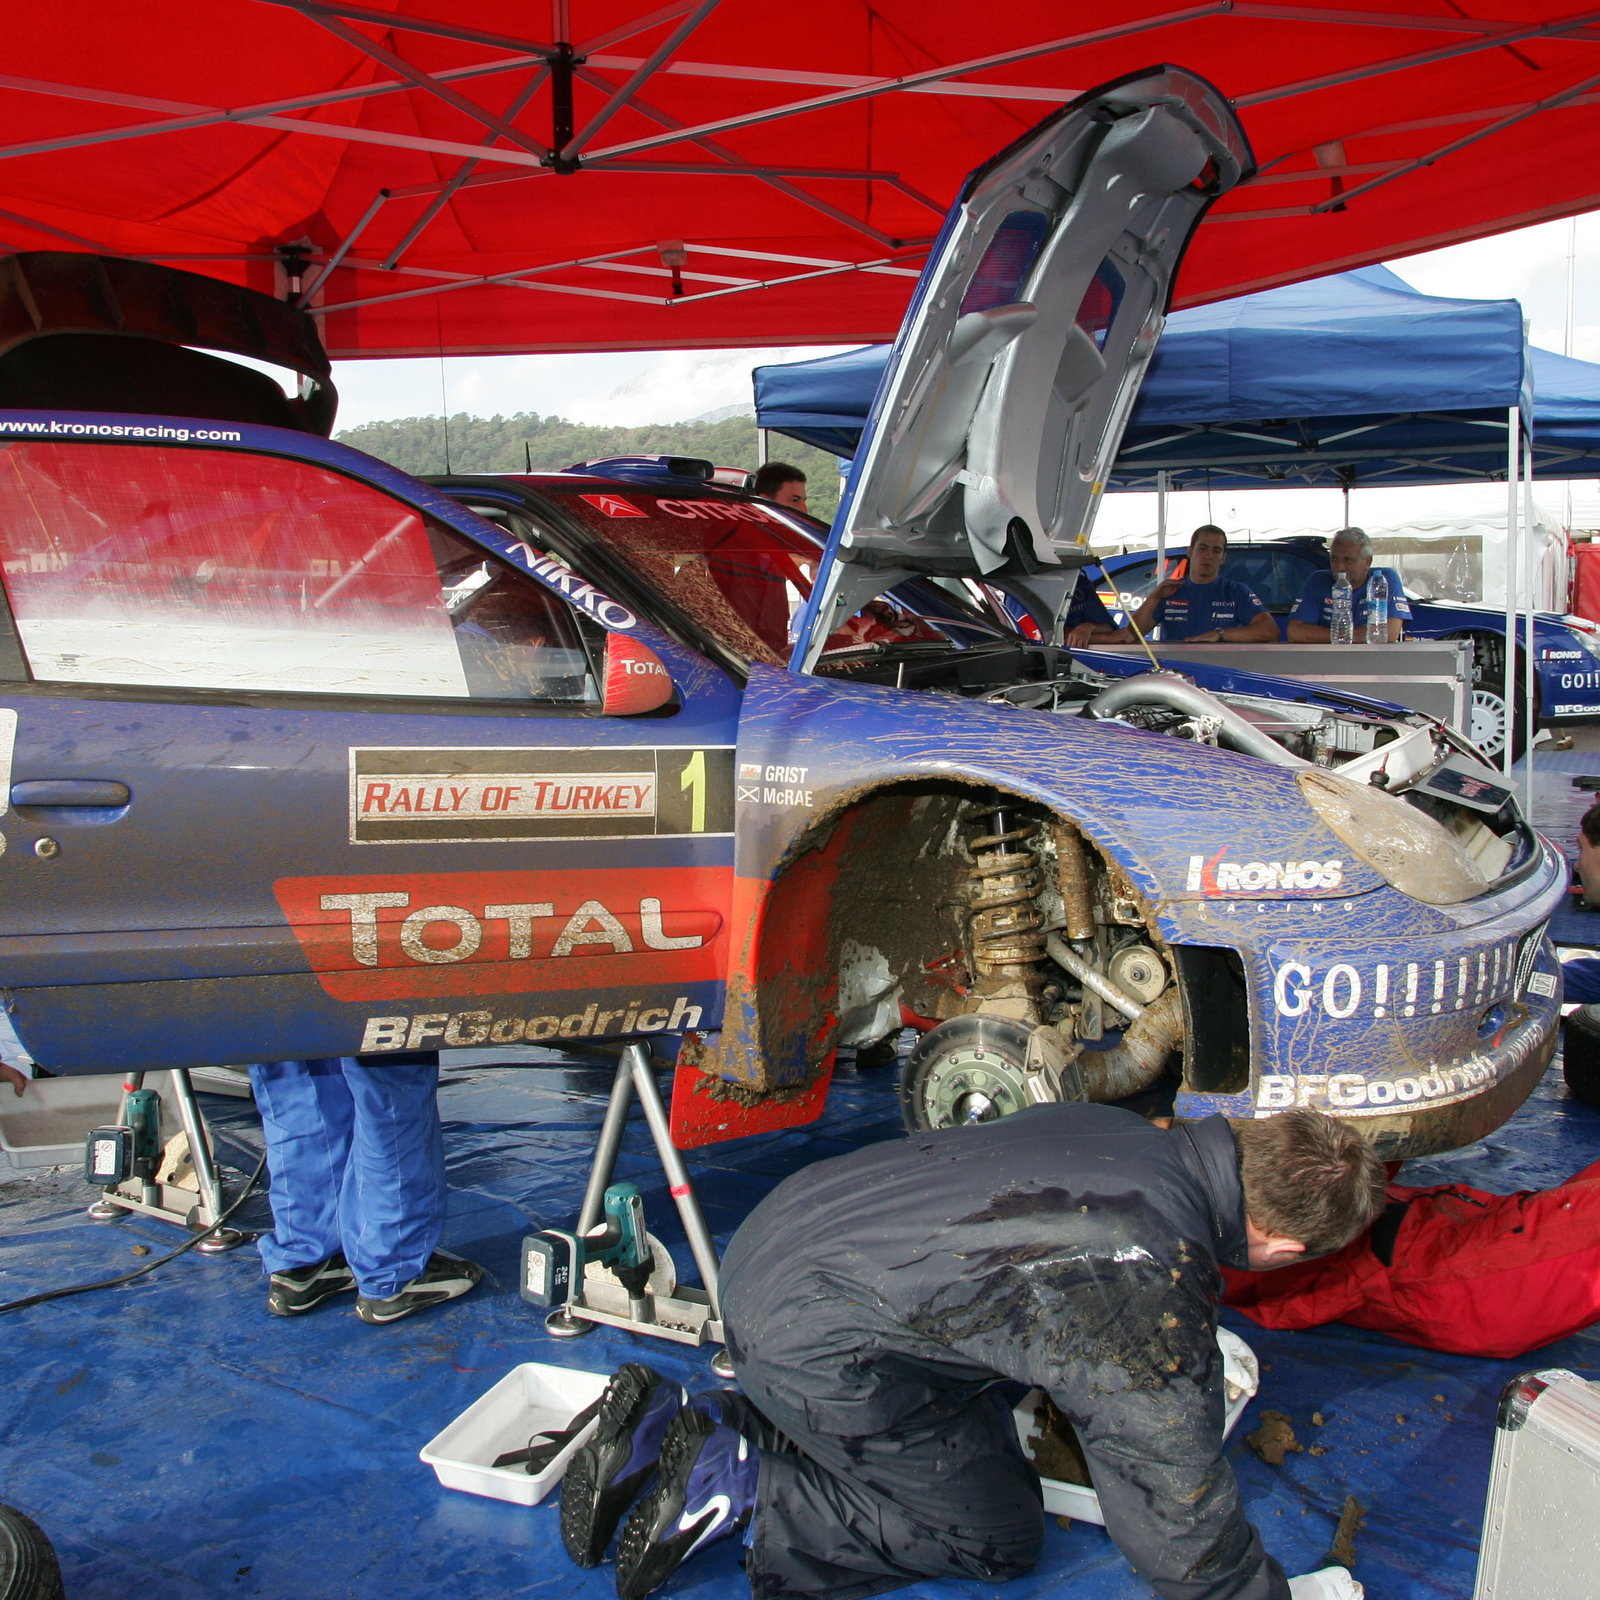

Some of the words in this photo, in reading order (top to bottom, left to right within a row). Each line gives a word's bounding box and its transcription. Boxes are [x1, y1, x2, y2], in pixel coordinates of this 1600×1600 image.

[0, 420, 241, 441] www.kronosracing.com
[656, 499, 781, 524] CITRO
[505, 542, 637, 629] NIKKO
[620, 659, 669, 676] TOTAL
[1542, 648, 1582, 660] KRONOS
[764, 765, 808, 784] GRIST
[361, 782, 470, 813] RALLY
[480, 786, 524, 811] OF
[533, 781, 652, 812] TURKEY
[680, 750, 706, 832] 1
[763, 787, 813, 808] McRAE
[1186, 845, 1344, 896] KRONOS
[1197, 902, 1354, 913] RACING
[320, 892, 703, 967] TOTAL
[360, 997, 703, 1053] BFGoodrich
[1256, 1050, 1497, 1108] BFGoodrich
